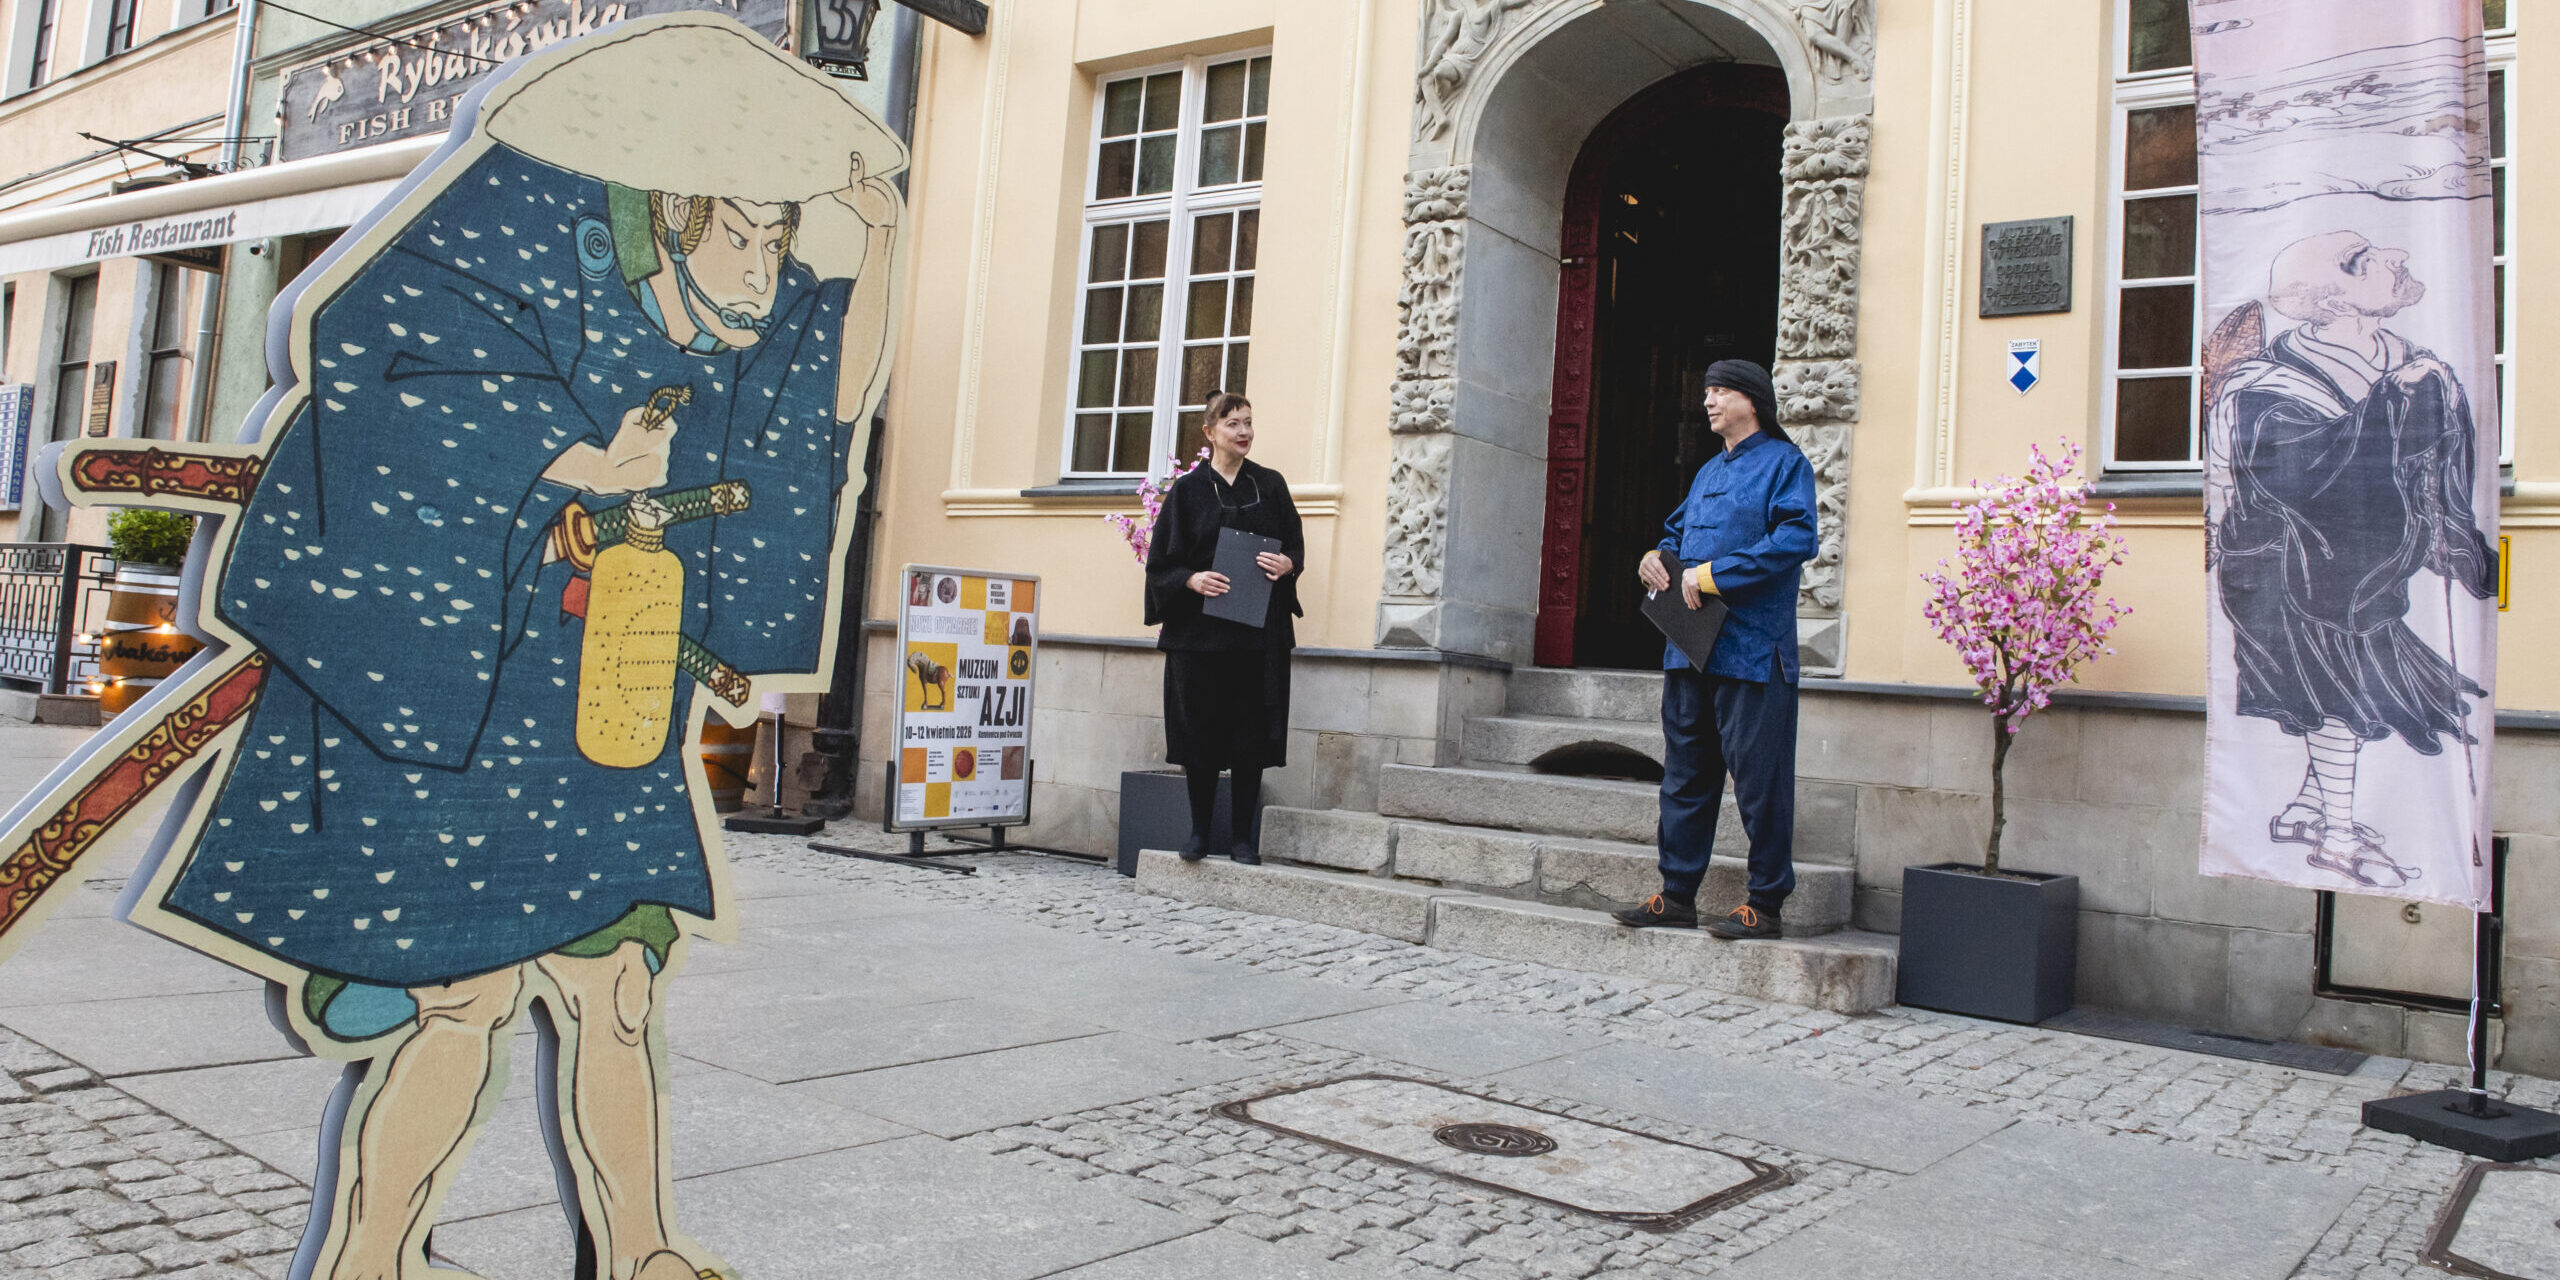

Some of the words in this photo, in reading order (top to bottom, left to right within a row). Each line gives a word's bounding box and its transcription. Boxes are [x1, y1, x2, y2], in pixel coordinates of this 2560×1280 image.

[339, 107, 412, 146] FISH
[86, 227, 124, 259] Fish
[127, 209, 236, 252] Restaurant
[18, 386, 32, 436] KANTOR
[11, 438, 25, 502] EXCHANGE
[959, 659, 998, 679] MUZEUM
[957, 686, 980, 699] SZTUKI
[979, 686, 1025, 726] AZJI
[926, 726, 955, 739] kwietnia
